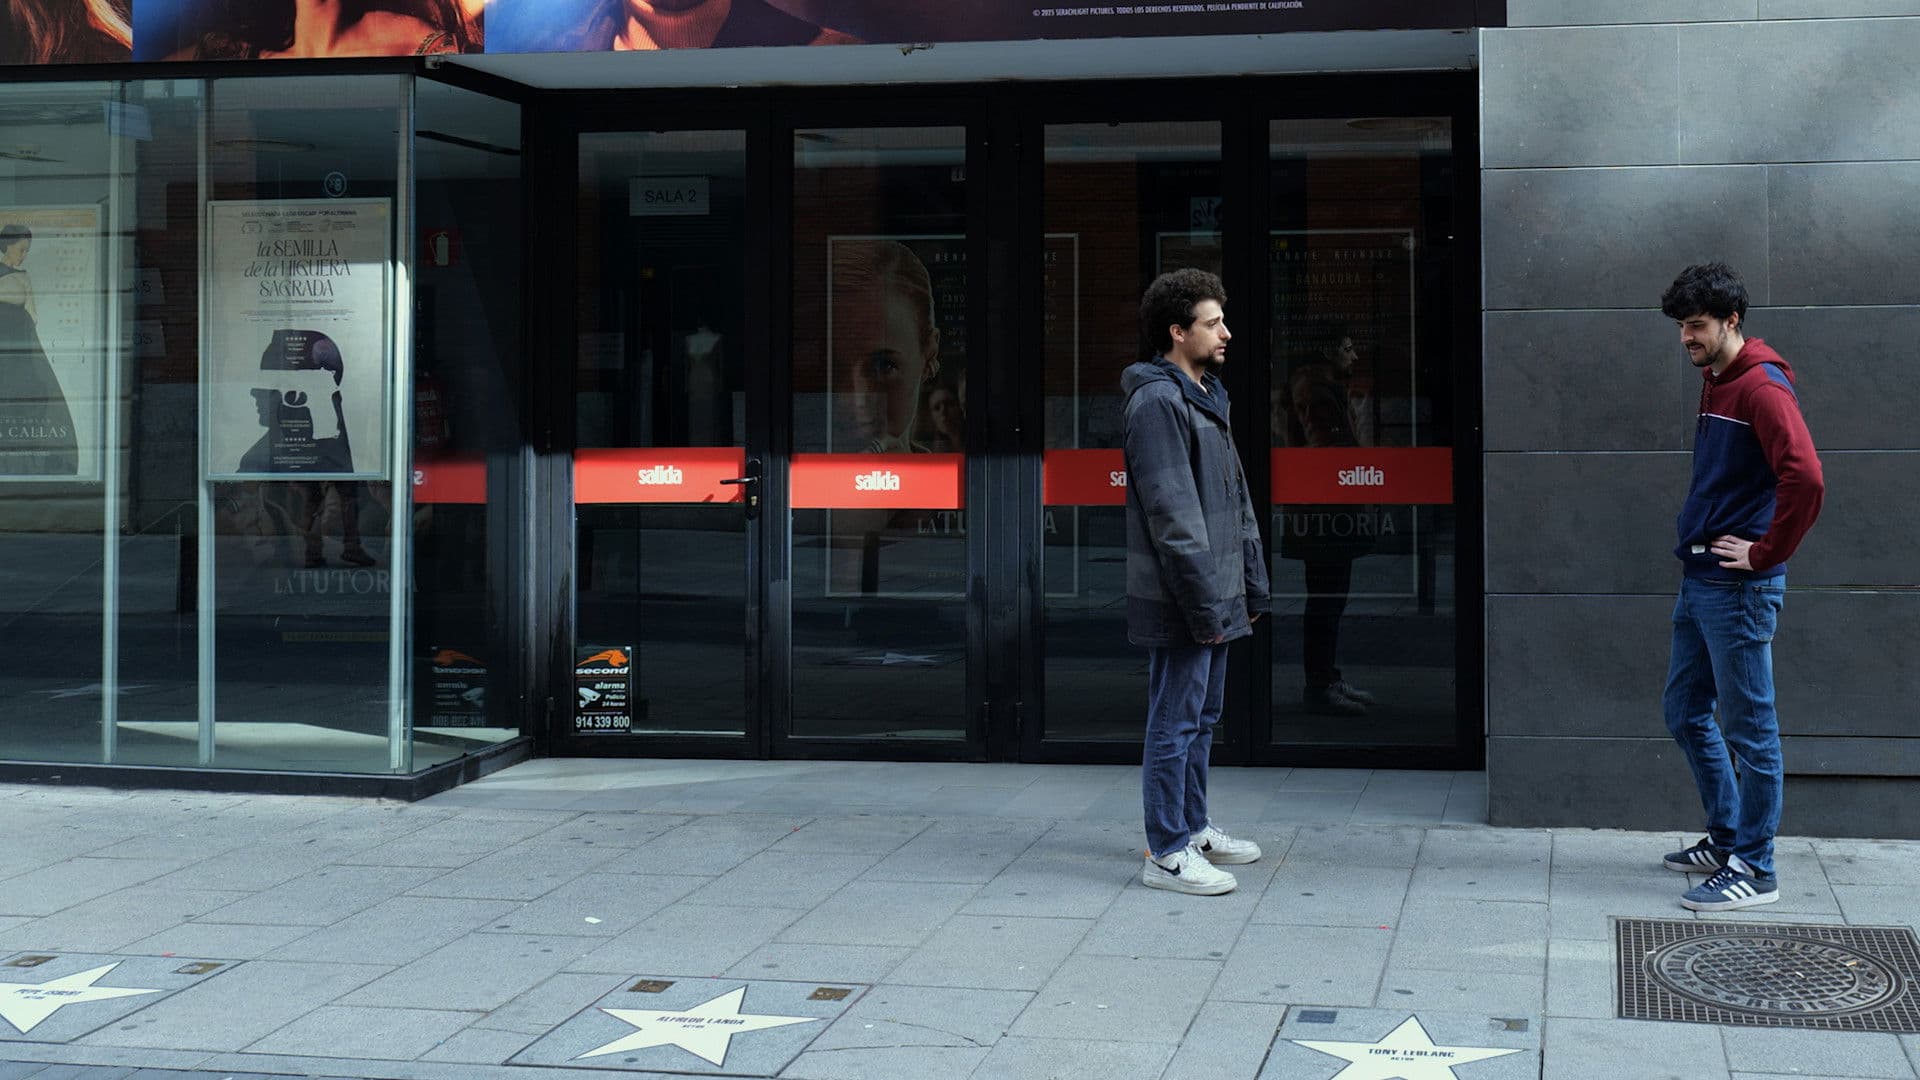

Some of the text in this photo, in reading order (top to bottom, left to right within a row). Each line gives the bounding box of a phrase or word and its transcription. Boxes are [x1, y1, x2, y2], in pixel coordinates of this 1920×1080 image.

[1117, 6, 1134, 14] TODOS
[1145, 5, 1172, 13] DERECHOS
[645, 189, 697, 202] SALA 2
[257, 239, 339, 257] la SEMILLA
[244, 259, 352, 278] de la HIGUERA
[260, 279, 334, 297] SAGRADA
[8, 425, 69, 439] CALLAS
[638, 465, 683, 485] salida
[855, 471, 900, 491] salida
[1110, 471, 1127, 488] sa
[1338, 466, 1384, 486] salida
[575, 666, 629, 675] second
[594, 681, 626, 690] alarma
[575, 715, 630, 729] 914 339 800
[655, 1016, 704, 1024] ALFREDO
[1403, 1050, 1456, 1058] LEBLANC
